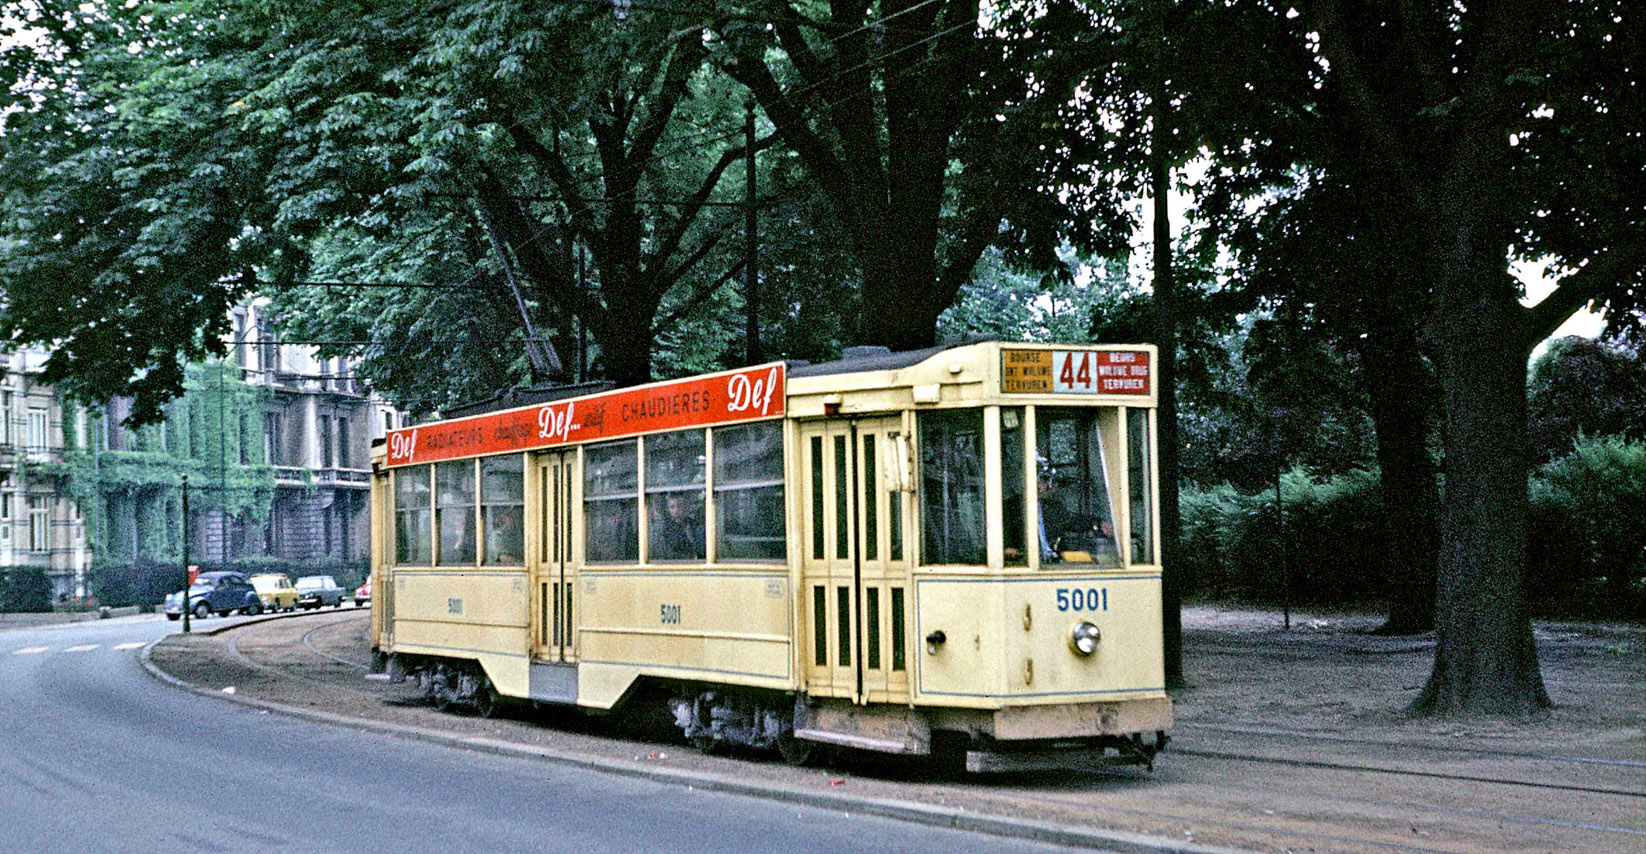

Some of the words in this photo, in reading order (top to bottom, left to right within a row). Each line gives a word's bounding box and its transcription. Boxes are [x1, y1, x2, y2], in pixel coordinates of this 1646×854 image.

[1060, 352, 1091, 389] 44
[1103, 378, 1144, 390] TERVUREN
[391, 429, 418, 463] Def
[426, 427, 483, 450] RADIATEURS
[727, 367, 777, 416] Def
[448, 598, 463, 614] 5001
[1056, 588, 1108, 611] 5001
[661, 604, 681, 624] 5001
